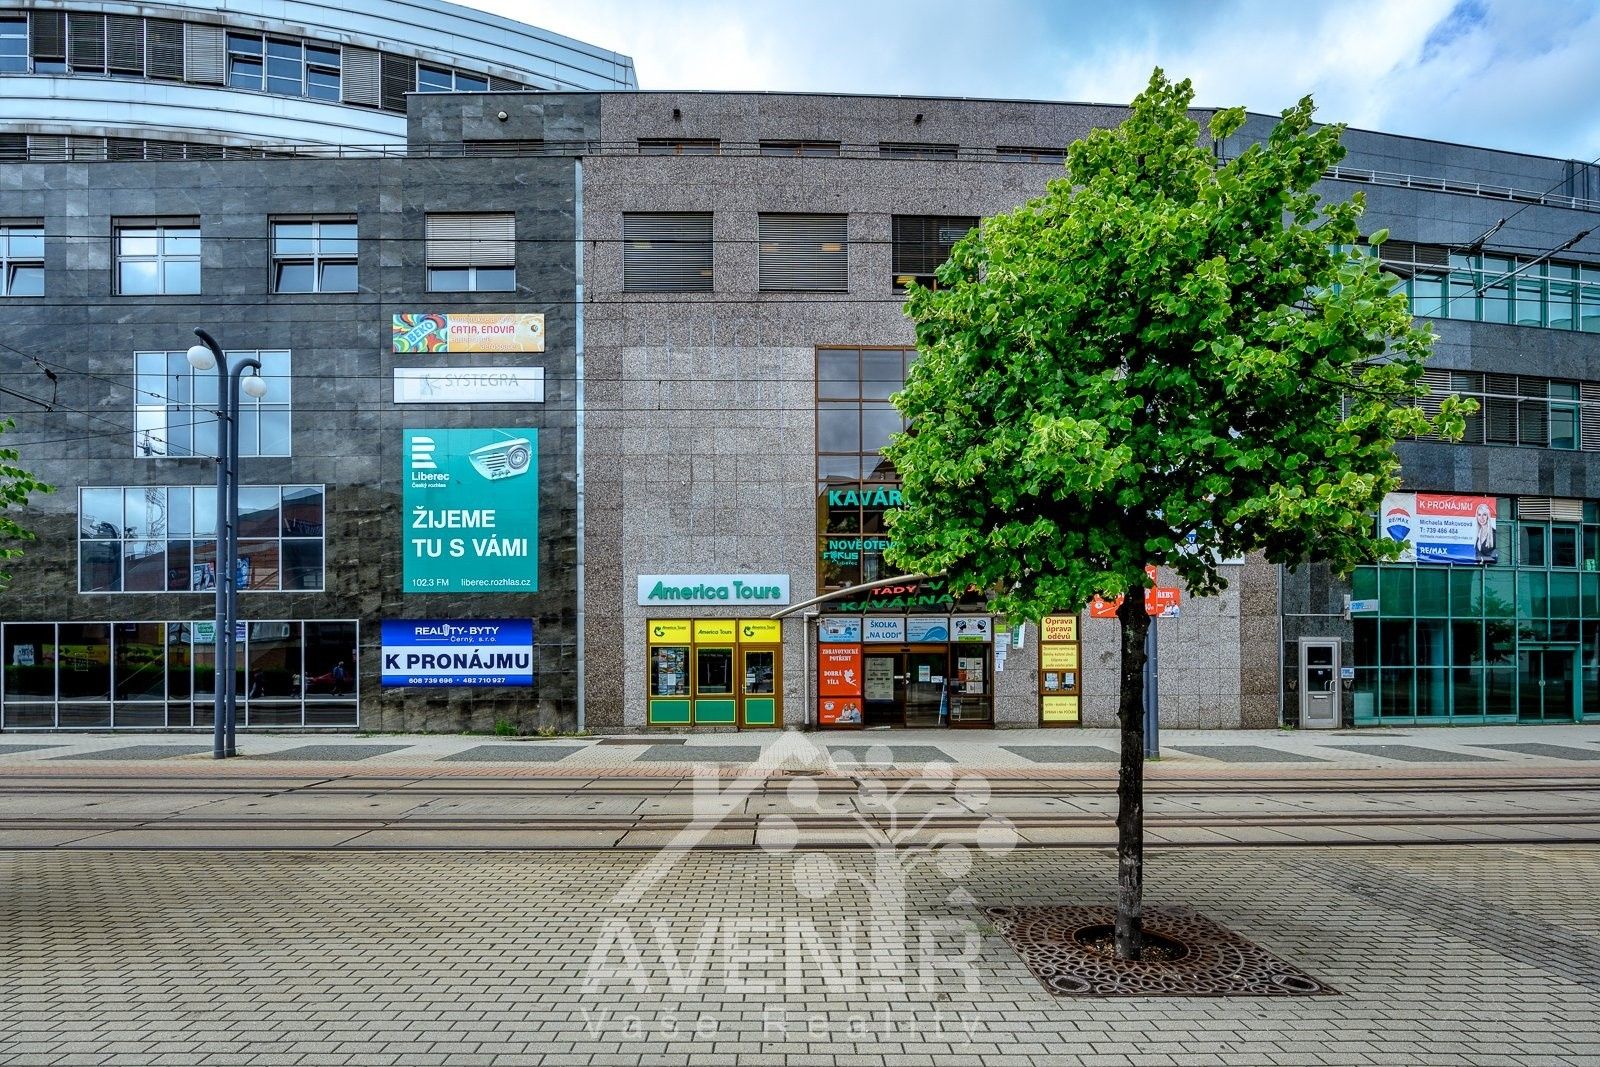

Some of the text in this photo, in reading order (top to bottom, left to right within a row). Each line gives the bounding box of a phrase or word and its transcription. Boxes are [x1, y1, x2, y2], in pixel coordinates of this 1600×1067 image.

[407, 321, 434, 343] BEKO
[451, 325, 515, 335] CATIA, ENOVIA
[445, 373, 518, 387] SYSTEGRA
[412, 472, 449, 481] Liberec
[829, 486, 902, 506] KAVÁR
[1419, 500, 1473, 511] K PRONÁJMU
[412, 505, 496, 528] ŽIJEME
[1388, 517, 1409, 525] RE/MAX
[412, 534, 528, 557] TU S VÁMI
[863, 540, 895, 550] OTEV
[1420, 547, 1448, 555] RE/MAX
[412, 578, 449, 587] 102.3 FM
[461, 578, 531, 587] liberec.rozhlas.cz
[648, 580, 781, 600] America Tours
[871, 584, 917, 595] TADY
[870, 620, 897, 629] ŠKOLKA
[1045, 617, 1073, 626] Oprava
[469, 627, 499, 635] BYTY
[1046, 625, 1072, 633] úprava
[385, 649, 529, 669] K PRONÁJMU
[823, 669, 842, 677] DOBRÁ
